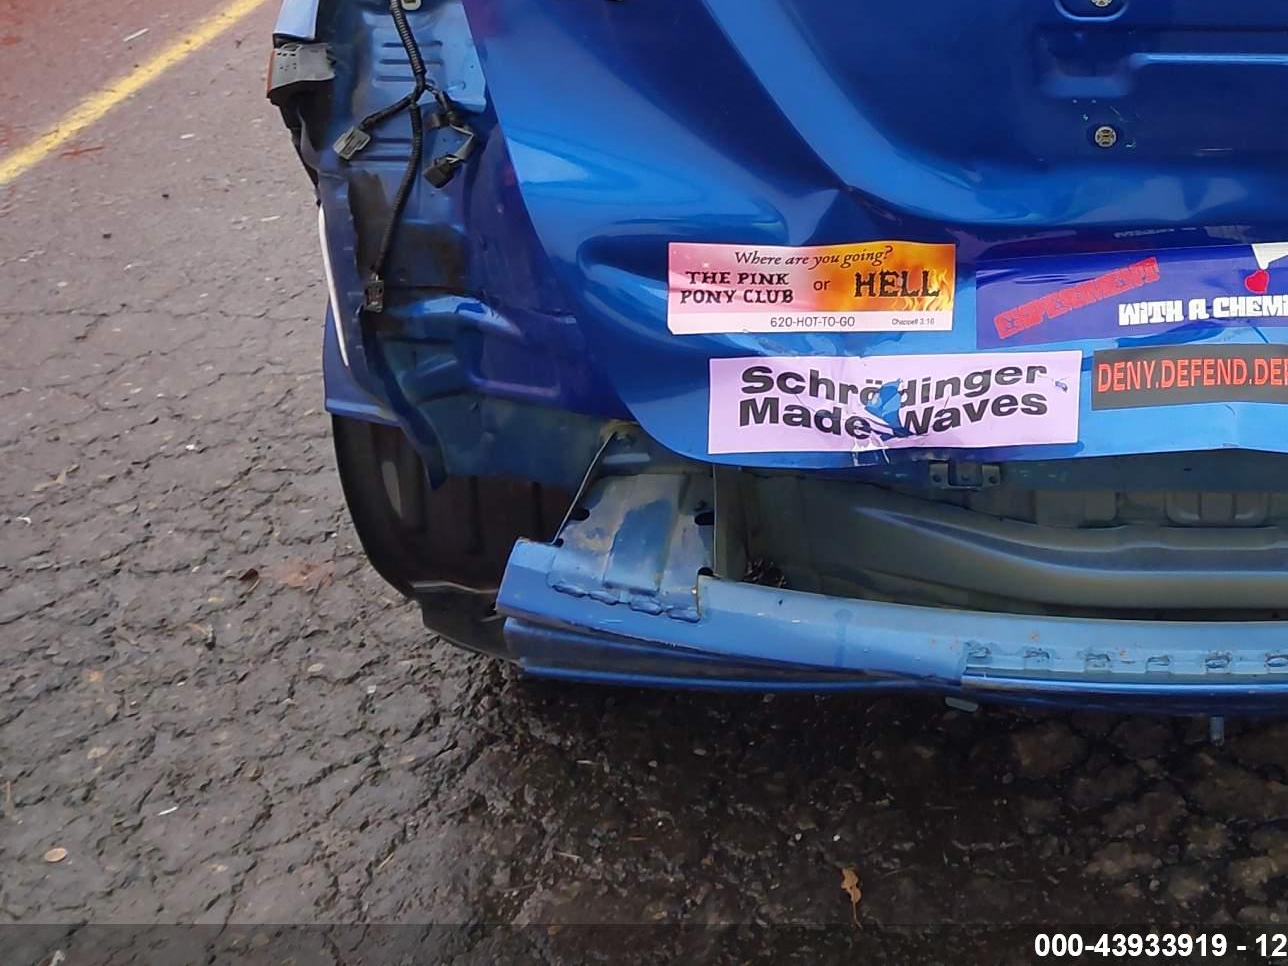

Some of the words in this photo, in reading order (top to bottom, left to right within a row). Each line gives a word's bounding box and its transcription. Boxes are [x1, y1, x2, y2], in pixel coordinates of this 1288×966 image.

[735, 251, 783, 266] Where
[784, 255, 810, 266] are
[808, 253, 840, 270] you
[839, 245, 894, 268] going?
[684, 271, 731, 285] THE
[737, 271, 790, 285] PINK
[812, 278, 831, 292] or
[853, 269, 941, 298] HELL
[680, 289, 737, 304] PONY
[743, 288, 794, 304] CLUB
[1188, 298, 1210, 320] A
[769, 316, 856, 328] 620-HOT-TO-GO
[739, 396, 871, 440] Made
[898, 393, 1049, 437] Waves
